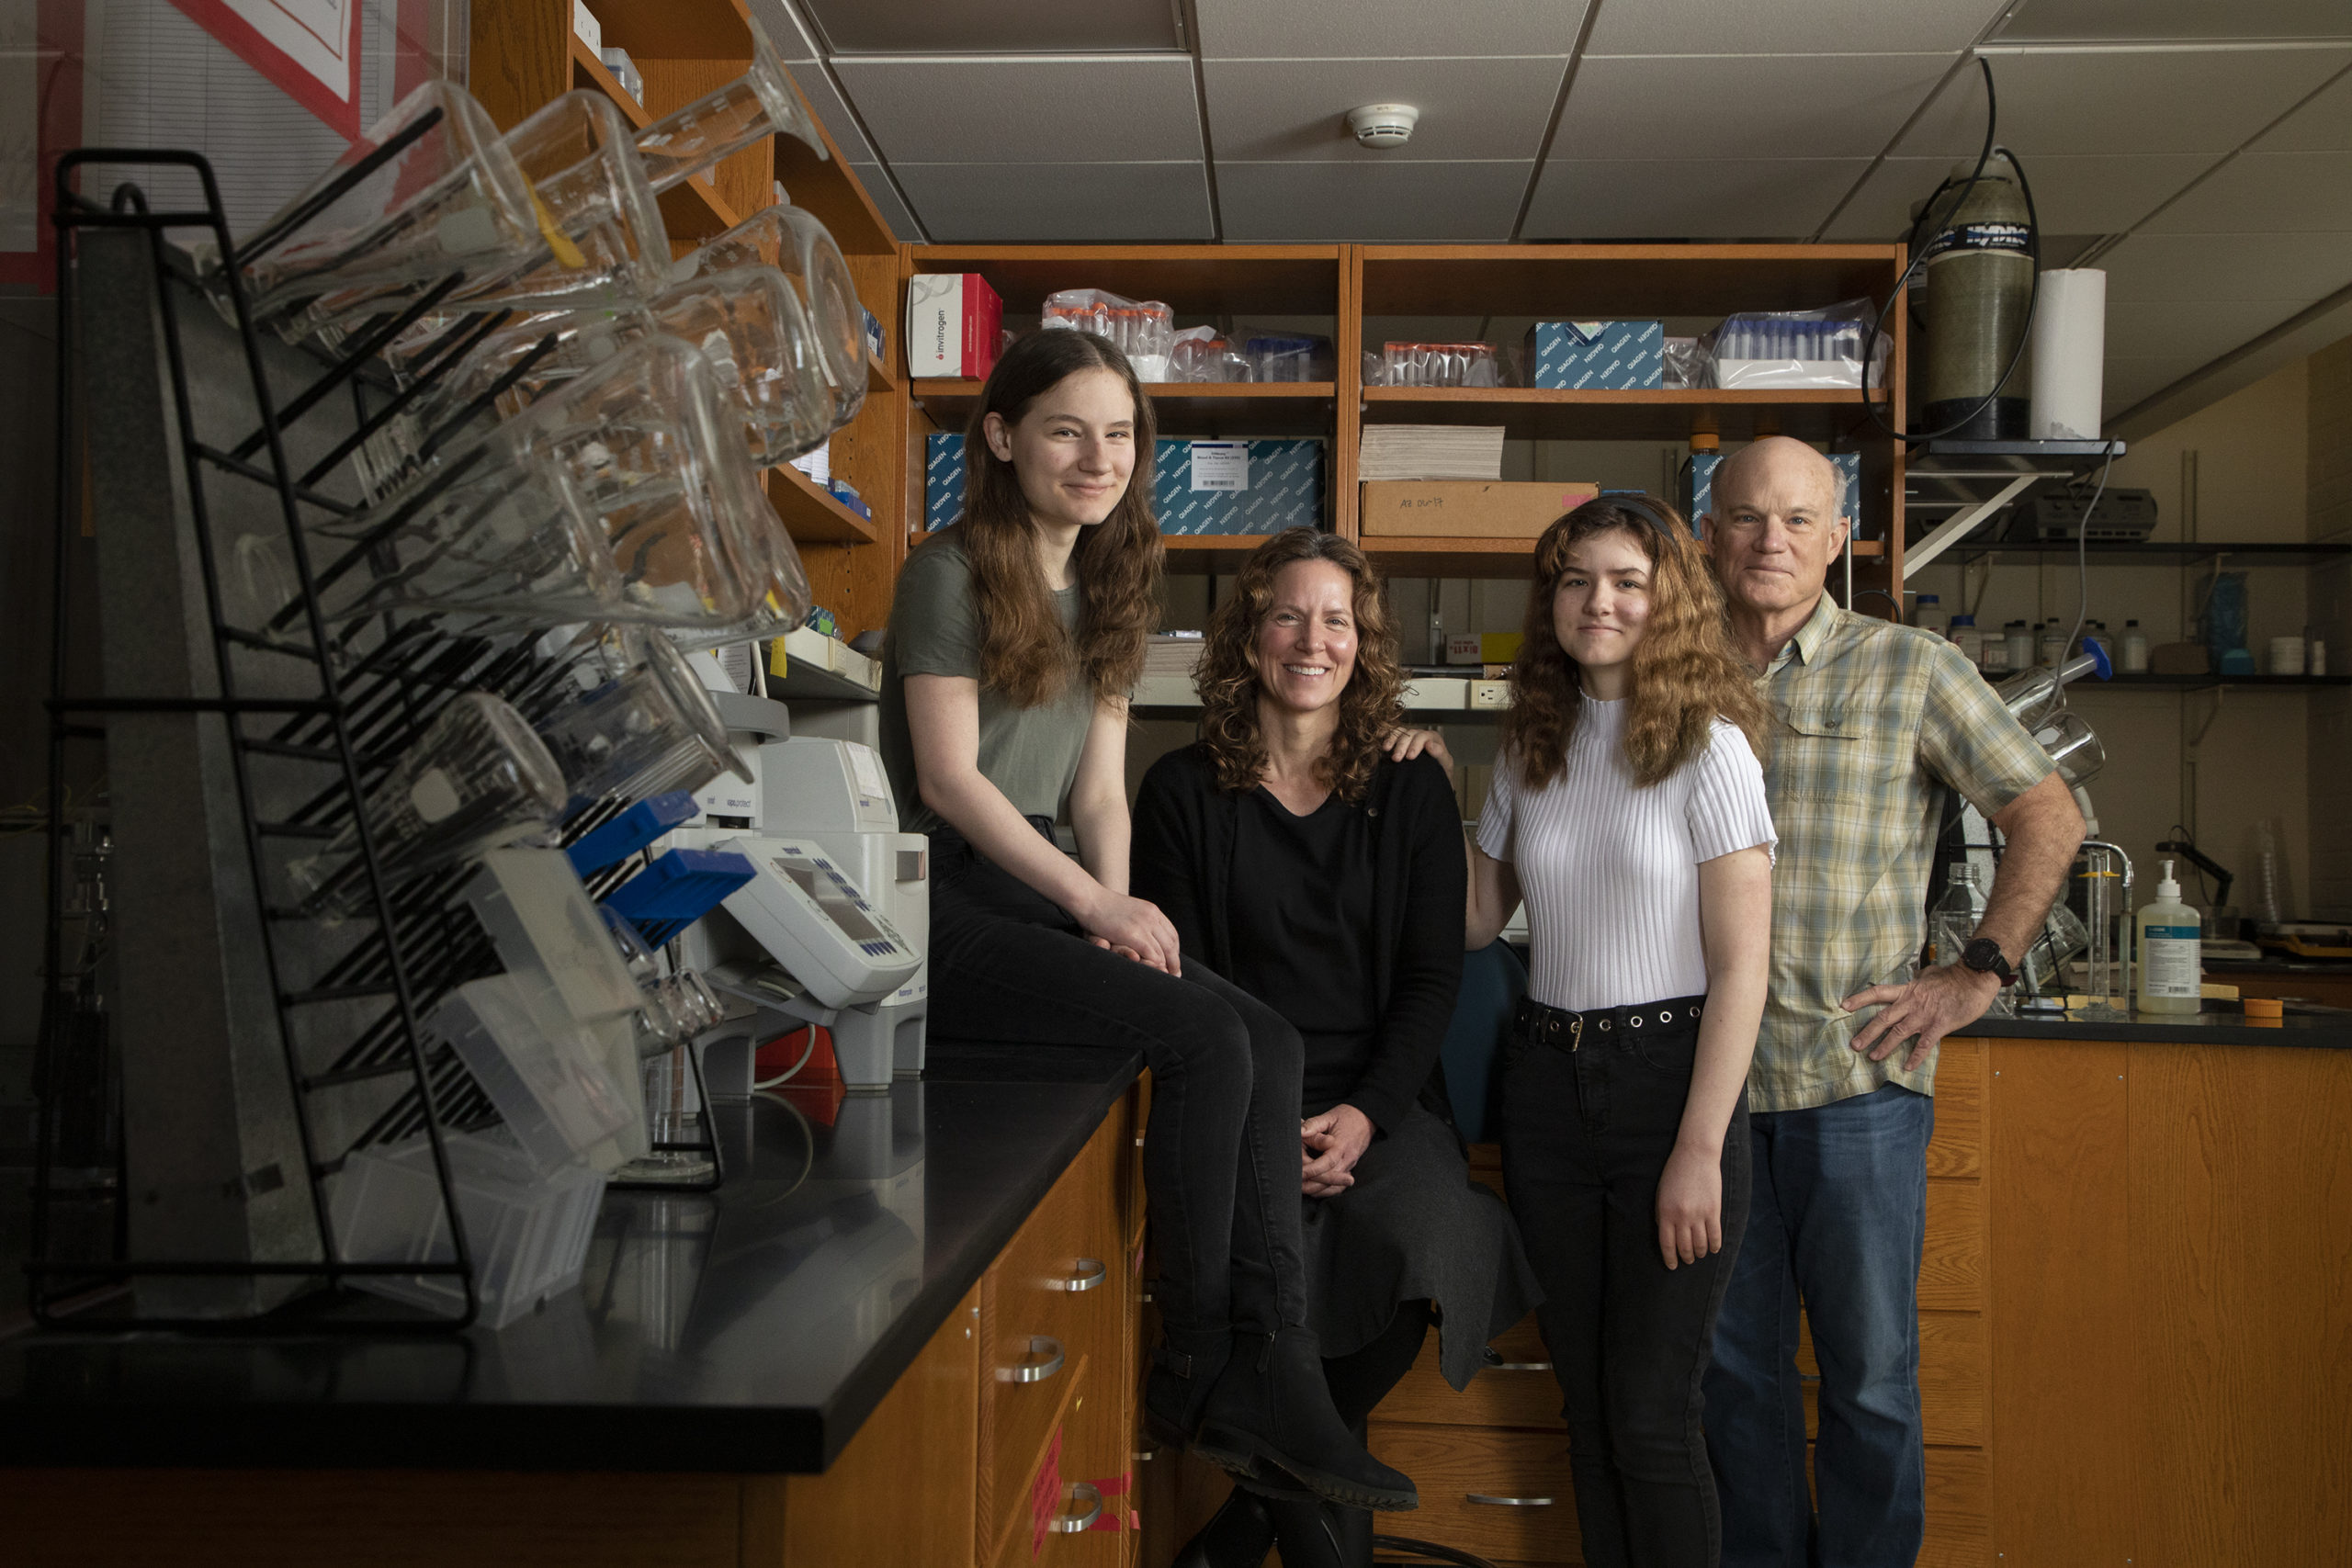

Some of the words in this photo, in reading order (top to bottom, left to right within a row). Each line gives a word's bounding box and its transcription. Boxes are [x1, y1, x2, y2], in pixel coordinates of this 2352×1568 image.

[936, 310, 946, 353] invitrogen
[1637, 322, 1658, 344] QIAGEN
[1541, 336, 1561, 356] QIAGEN
[1611, 333, 1632, 354] QIAGEN
[1584, 343, 1604, 364] QIAGEN
[1627, 349, 1647, 370] QIAGEN
[1557, 353, 1577, 374] QIAGEN
[1600, 359, 1621, 380] QIAGEN
[1573, 369, 1594, 389] QIAGEN
[1643, 366, 1663, 387] QIAGEN
[928, 451, 946, 470] QIAGEN
[1157, 445, 1176, 463] QIAGEN
[1264, 446, 1283, 465] QIAGEN
[1172, 459, 1192, 479] QIAGEN
[1280, 461, 1299, 480] QIAGEN
[1703, 455, 1724, 476] QIAGEN
[943, 467, 962, 486] QIAGEN
[1254, 471, 1273, 490] QIAGEN
[1163, 485, 1182, 503] QIAGEN
[1270, 487, 1289, 505] QIAGEN
[1295, 477, 1314, 496] QIAGEN
[932, 492, 951, 511] QIAGEN
[1179, 500, 1198, 519] QIAGEN
[1204, 491, 1223, 510] QIAGEN
[1245, 496, 1264, 515] QIAGEN
[1194, 515, 1214, 535] QIAGEN
[1219, 506, 1238, 525] QIAGEN
[1261, 512, 1280, 530] QIAGEN
